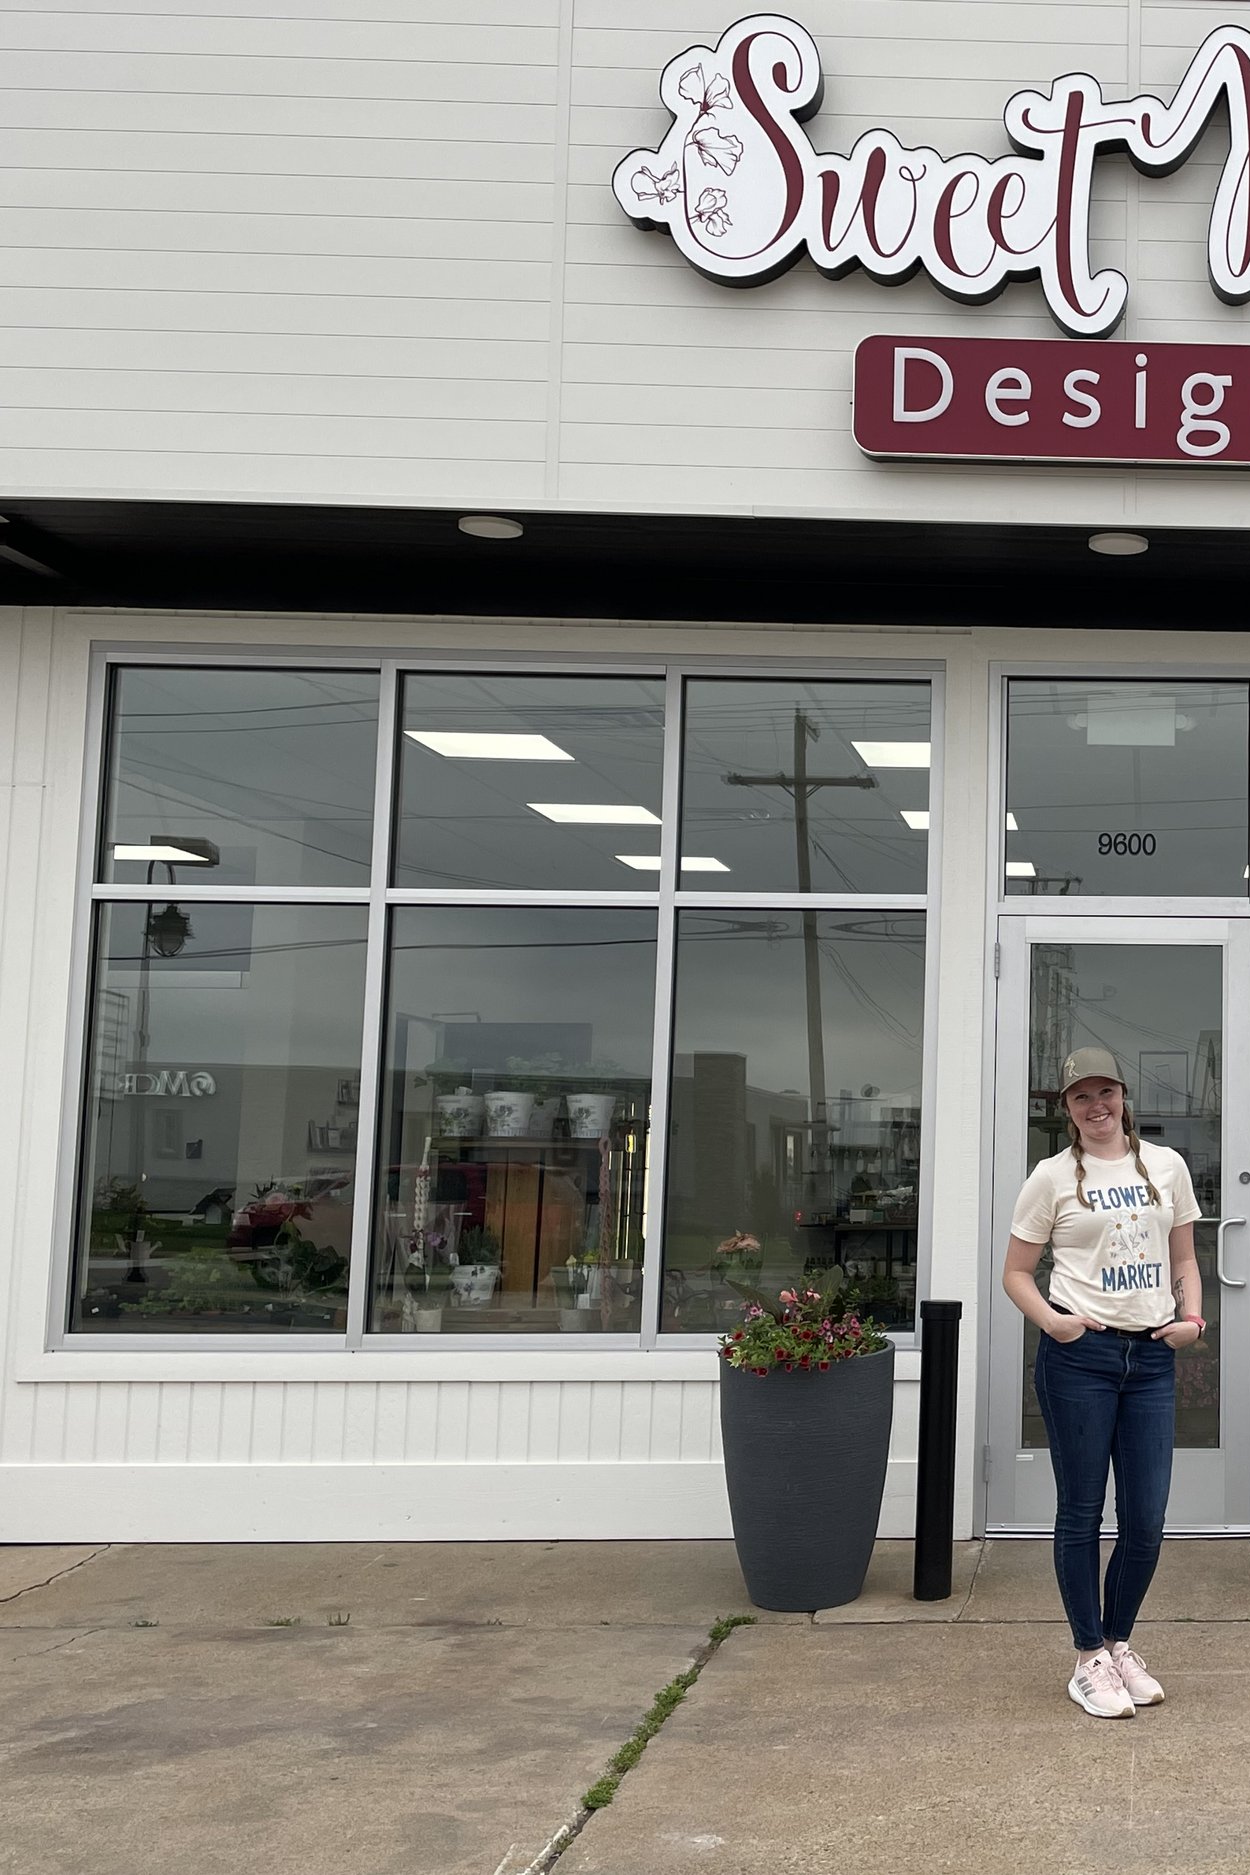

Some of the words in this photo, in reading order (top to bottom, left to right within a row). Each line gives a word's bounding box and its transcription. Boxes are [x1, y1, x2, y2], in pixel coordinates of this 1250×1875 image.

[683, 32, 1136, 317] Sweet
[1098, 832, 1157, 856] 9600
[1102, 1263, 1162, 1292] MARKET
